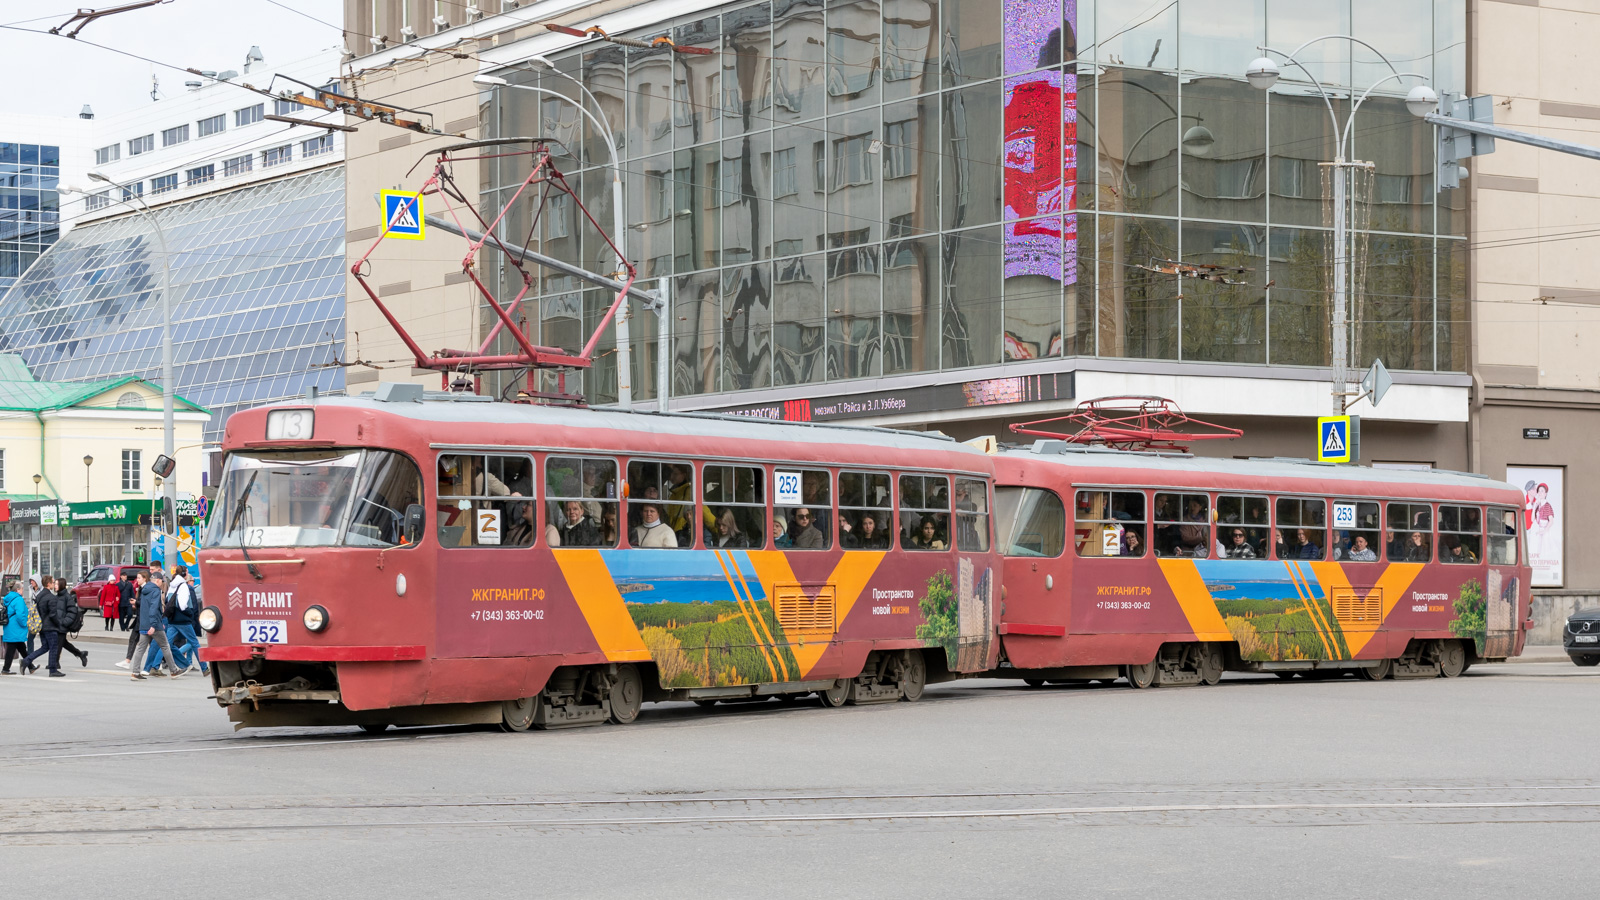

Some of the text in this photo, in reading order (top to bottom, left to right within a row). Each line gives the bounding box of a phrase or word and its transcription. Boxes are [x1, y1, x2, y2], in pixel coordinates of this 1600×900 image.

[751, 407, 780, 419] РОССИИ
[814, 405, 837, 416] мюзикл
[843, 402, 861, 413] Райса
[861, 403, 867, 411] и
[880, 397, 906, 411] Уэббера
[281, 411, 303, 438] 13
[779, 475, 798, 494] 252
[176, 500, 198, 510] Жизн
[1336, 507, 1353, 521] 253
[480, 513, 498, 533] Z
[248, 528, 264, 546] 13
[1105, 533, 1118, 546] Z
[472, 588, 545, 601] ЖКГРАНИТ.РФ
[872, 588, 914, 601] Пространство
[1097, 586, 1151, 596] ЖКГРАНИТ.РФ
[1412, 591, 1448, 602] Пространство
[246, 592, 293, 608] ГРАНИТ
[1104, 601, 1119, 609] (343)
[1120, 601, 1151, 609] 363-00-02
[872, 604, 891, 615] новой
[1412, 604, 1428, 612] новой
[471, 609, 544, 621] +7 (343) 363-00-02
[248, 625, 280, 643] 252
